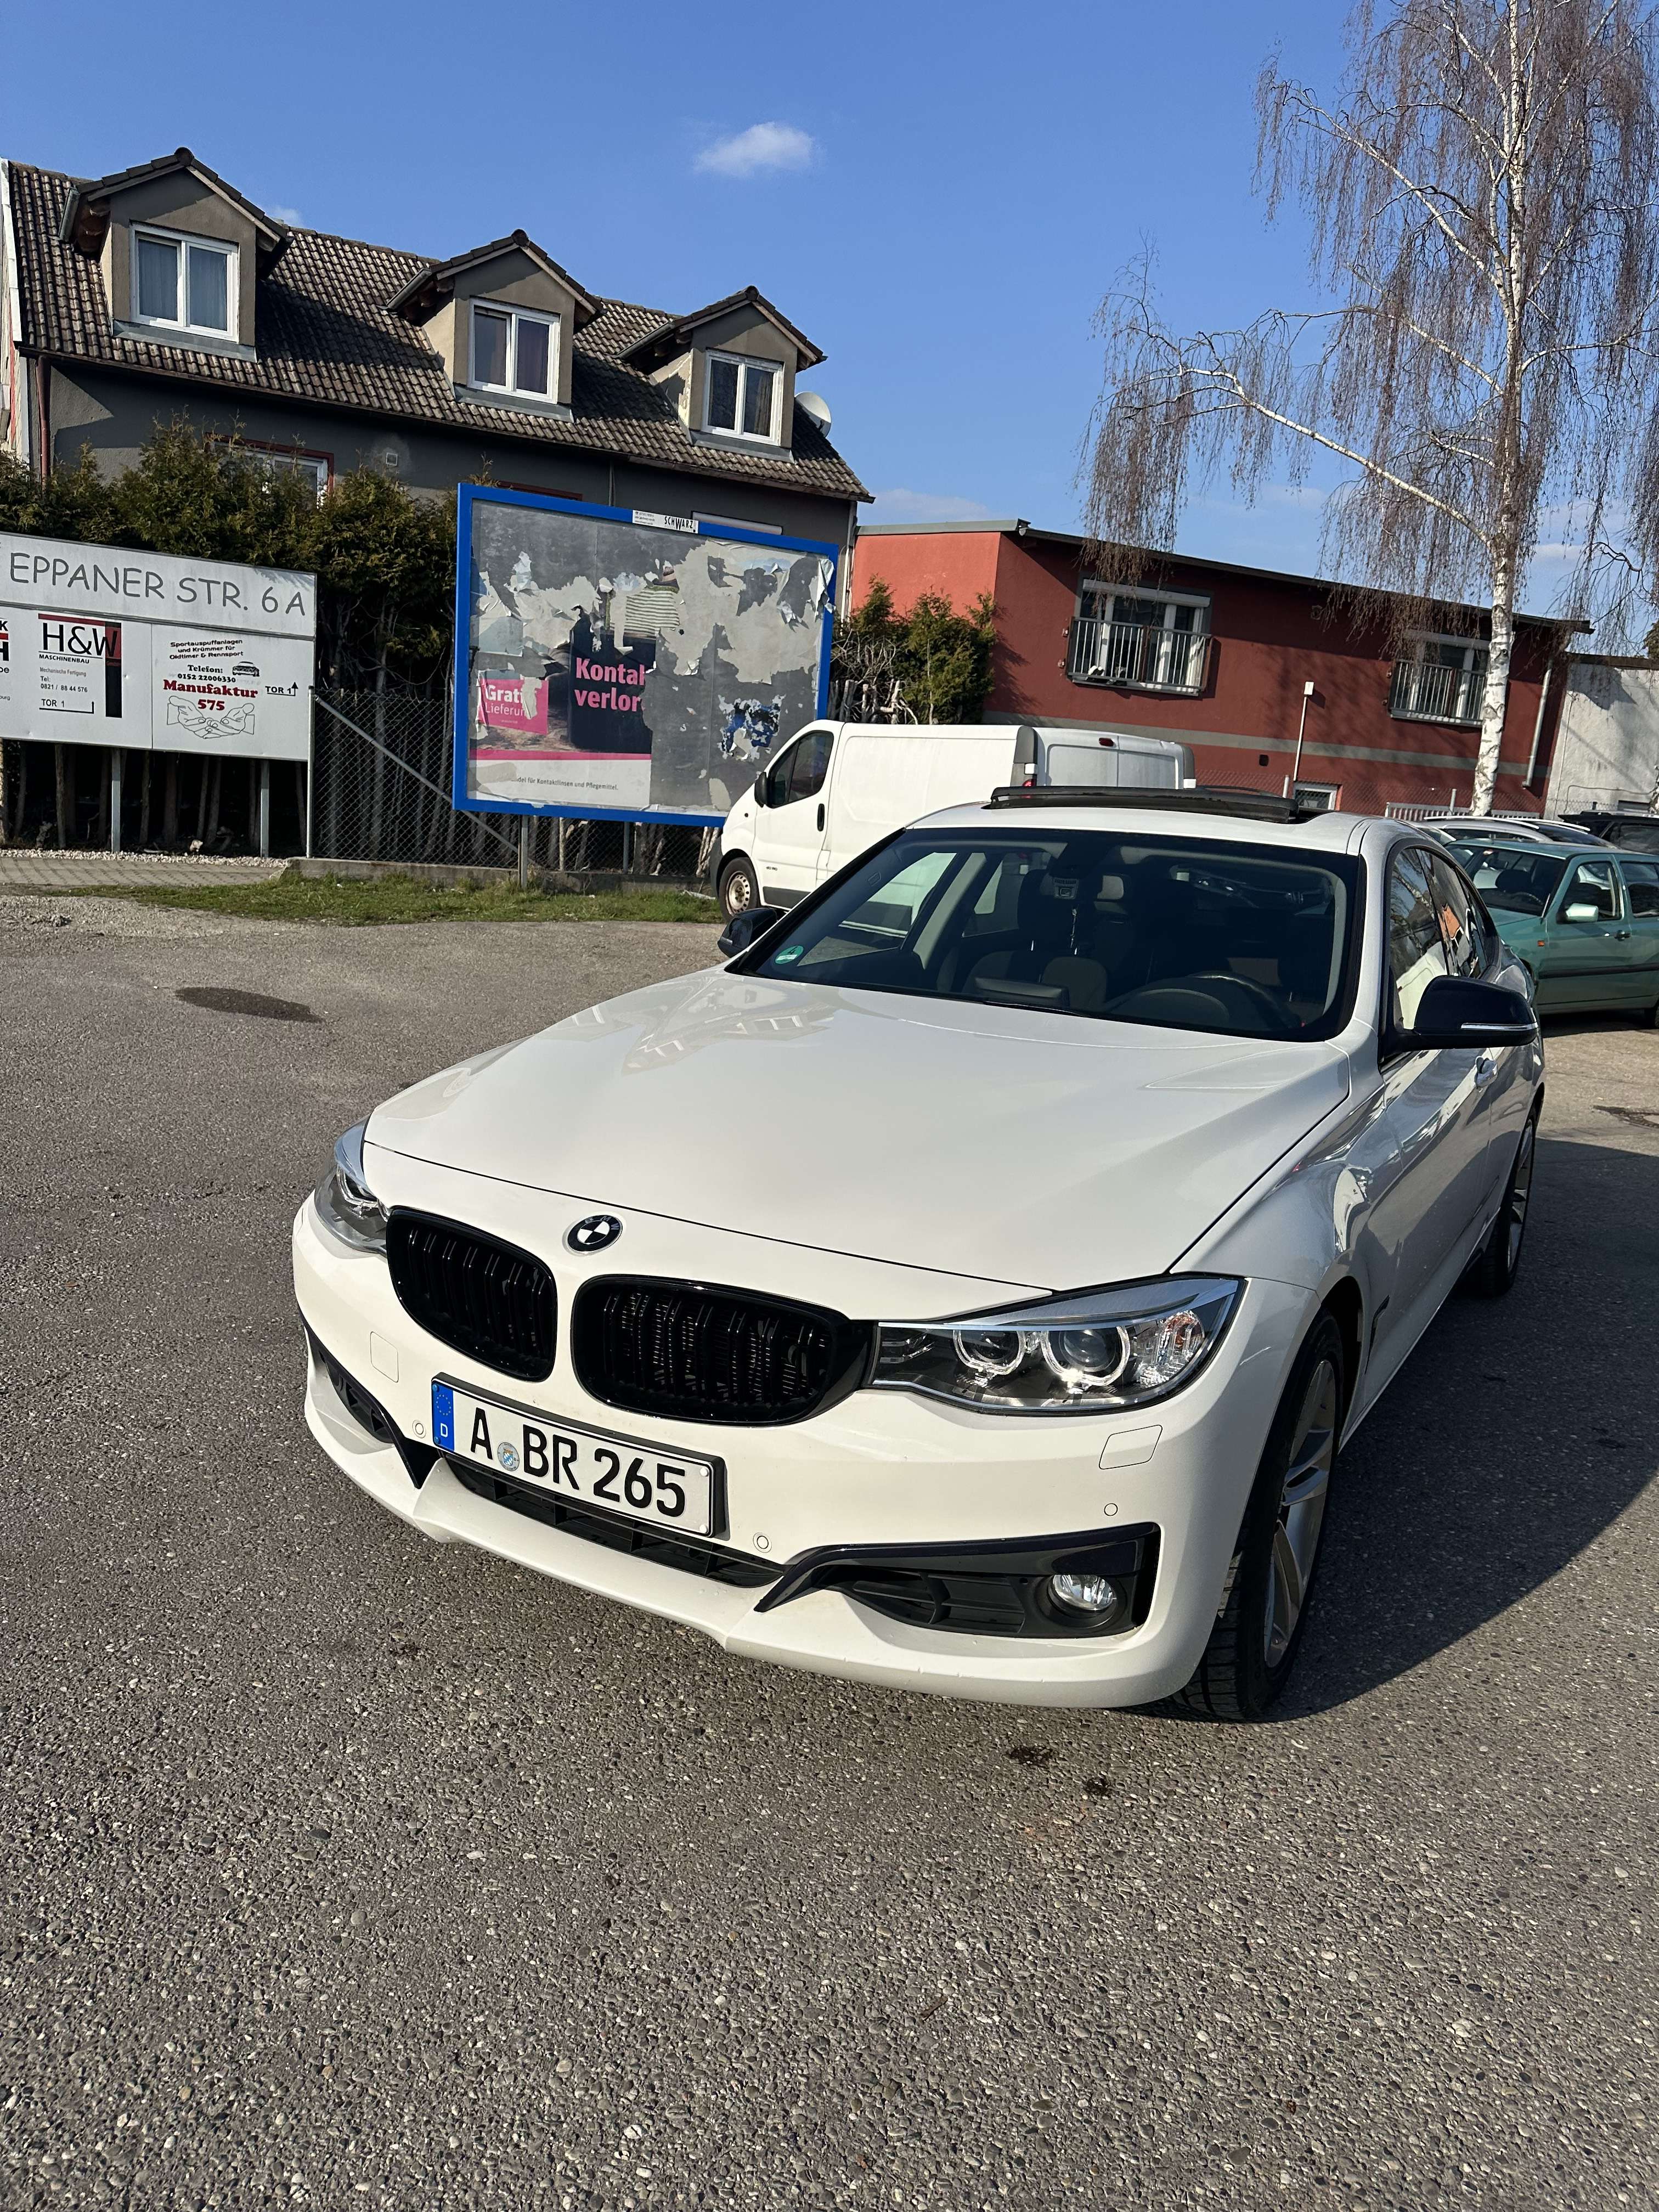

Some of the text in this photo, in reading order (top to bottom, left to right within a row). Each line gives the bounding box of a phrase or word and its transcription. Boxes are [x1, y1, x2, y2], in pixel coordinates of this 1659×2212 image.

[10, 552, 165, 599] EPPANER
[177, 577, 249, 610] STR.
[43, 623, 118, 657] H&W
[39, 654, 89, 663] MASCHINENBAU
[187, 664, 223, 674] Telefon:
[163, 679, 258, 698] Manufaktur
[486, 685, 524, 703] Grati
[41, 699, 57, 707] TOR
[198, 699, 225, 711] 575
[574, 687, 645, 712] verlor
[537, 778, 573, 787] Kontaktlinsen
[585, 1215, 619, 1230] BMW
[439, 1423, 448, 1438] D
[470, 1407, 493, 1460] A
[523, 1424, 580, 1491] BR
[593, 1447, 686, 1517] 265
